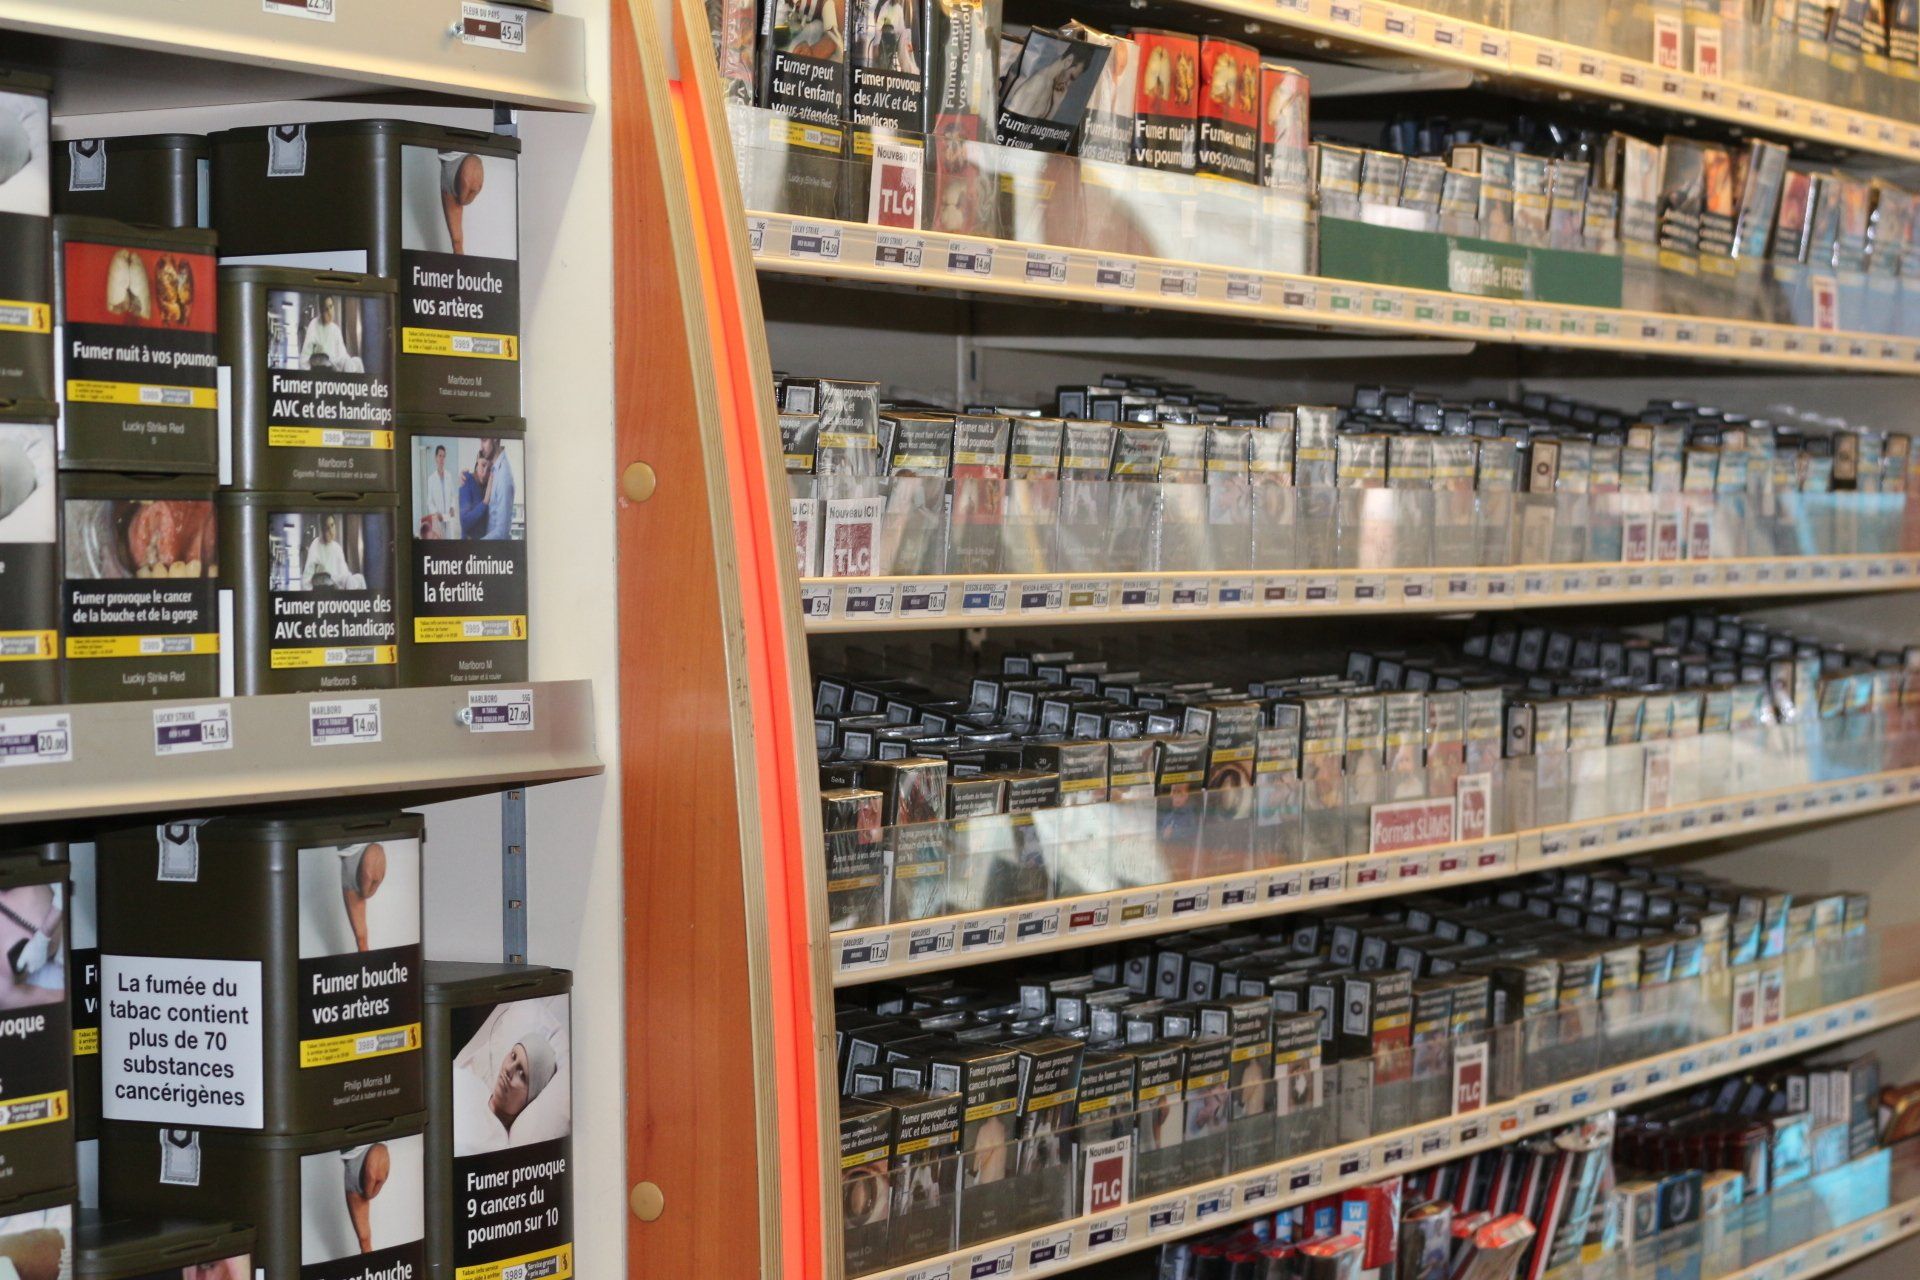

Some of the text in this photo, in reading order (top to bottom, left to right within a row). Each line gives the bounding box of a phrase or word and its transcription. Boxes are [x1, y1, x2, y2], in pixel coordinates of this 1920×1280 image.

[502, 25, 521, 41] 45.40
[776, 55, 834, 82] Fumer peut
[854, 69, 884, 87] Fumer
[773, 77, 796, 95] tuer
[798, 80, 834, 104] l'enfant
[854, 89, 917, 112] des AVC et des
[771, 102, 799, 118] vous
[854, 109, 899, 129] handicaps
[999, 112, 1070, 141] Fumer augmente
[1085, 117, 1112, 138] Fumer
[1201, 122, 1234, 145] Fumer
[1154, 150, 1196, 168] poumons
[881, 188, 914, 216] TLC
[413, 266, 503, 294] Fumer bouche
[1501, 264, 1530, 289] FRESH
[413, 296, 484, 320] vos artères
[73, 341, 113, 360] Fumer
[116, 344, 140, 362] nuit
[142, 345, 150, 363] à
[152, 350, 172, 365] vos
[272, 375, 389, 401] Fumer provoque des
[448, 375, 482, 386] Marlboro M
[272, 399, 392, 425] AVC et des handicaps
[123, 420, 185, 435] Lucky Strike Red
[958, 423, 978, 434] Fumer
[829, 506, 864, 519] Nouveau
[424, 554, 514, 576] Fumer diminue
[834, 547, 871, 573] TLC
[73, 590, 192, 607] Fumer provoque le cancer
[424, 581, 484, 602] la fertilité
[848, 586, 862, 594] AUSTIN
[902, 585, 917, 593] BASTOS
[275, 594, 392, 619] Fumer provoque des
[879, 597, 892, 611] 9.70
[73, 607, 199, 624] de la bouche et de la gorge
[275, 618, 395, 640] AVC et des handicaps
[459, 660, 493, 670] Marlboro M
[123, 671, 186, 685] Lucky Strike Red
[321, 675, 357, 687] Marlboro S
[471, 694, 498, 704] MARLBORO
[176, 711, 195, 721] STRIKE
[312, 705, 342, 715] MARLBORO
[509, 707, 529, 721] 27.00
[203, 724, 226, 740] 14.10
[355, 718, 375, 732] 14.00
[1039, 757, 1047, 765] 20
[1374, 813, 1449, 845] Format SLIMS
[1462, 808, 1484, 831] TLC
[872, 944, 886, 959] 11.20
[118, 973, 237, 997] La fumée du
[313, 962, 408, 996] Fumer bouche
[110, 1000, 249, 1025] tabac contient
[312, 995, 390, 1025] vos artères
[129, 1028, 227, 1051] plus de 70
[123, 1055, 234, 1079] substances
[969, 1066, 986, 1077] Fumer
[987, 1061, 1011, 1076] provoque
[344, 1073, 392, 1092] Philip Morris M
[969, 1073, 1017, 1091] cancers du poumon
[1459, 1081, 1480, 1104] TLC
[115, 1082, 245, 1108] cancérigènes
[978, 1092, 985, 1102] 10
[902, 1104, 957, 1126] Fumer provoque des
[901, 1118, 958, 1139] AVC et des handicaps
[467, 1158, 566, 1192] Fumer provoque
[467, 1185, 545, 1218] 9 cancers du
[1093, 1178, 1120, 1206] TLC
[1349, 1205, 1361, 1219] W
[468, 1207, 559, 1249] poumon sur 10
[504, 1268, 523, 1280] 3989
